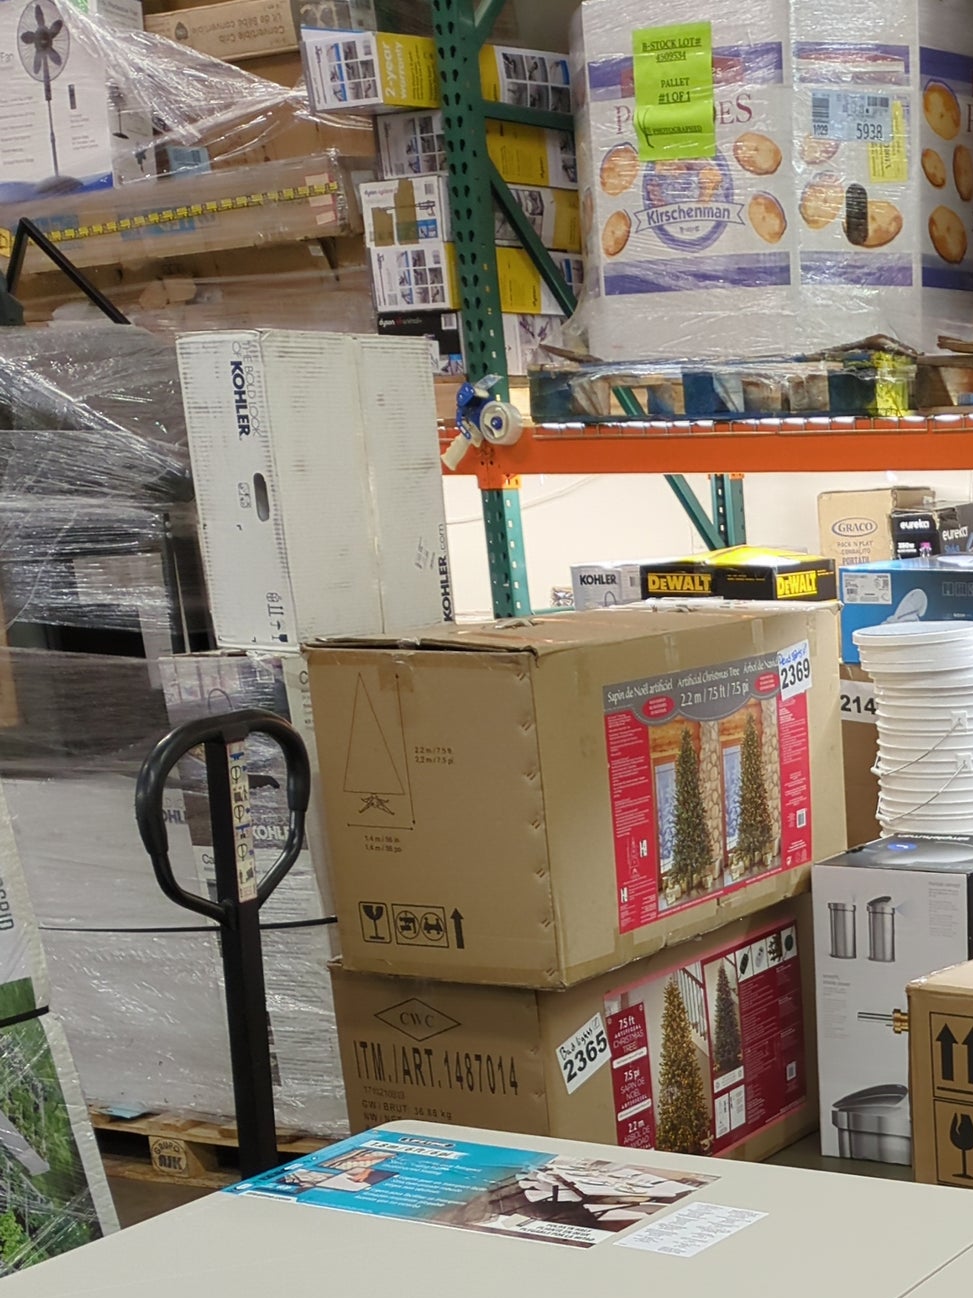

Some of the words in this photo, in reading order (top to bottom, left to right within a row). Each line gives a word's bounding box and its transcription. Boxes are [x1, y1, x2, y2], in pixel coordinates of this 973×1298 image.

[660, 77, 690, 88] PALLET
[856, 123, 883, 140] 5938
[646, 205, 731, 226] Kirschenman
[230, 360, 250, 437] KOHLER
[838, 521, 873, 533] GRACO
[900, 518, 930, 530] eureka
[942, 525, 968, 541] eureka
[579, 574, 617, 586] KOHLER
[780, 658, 811, 690] 2369
[400, 1010, 435, 1029] CWC
[562, 1030, 608, 1084] 2365
